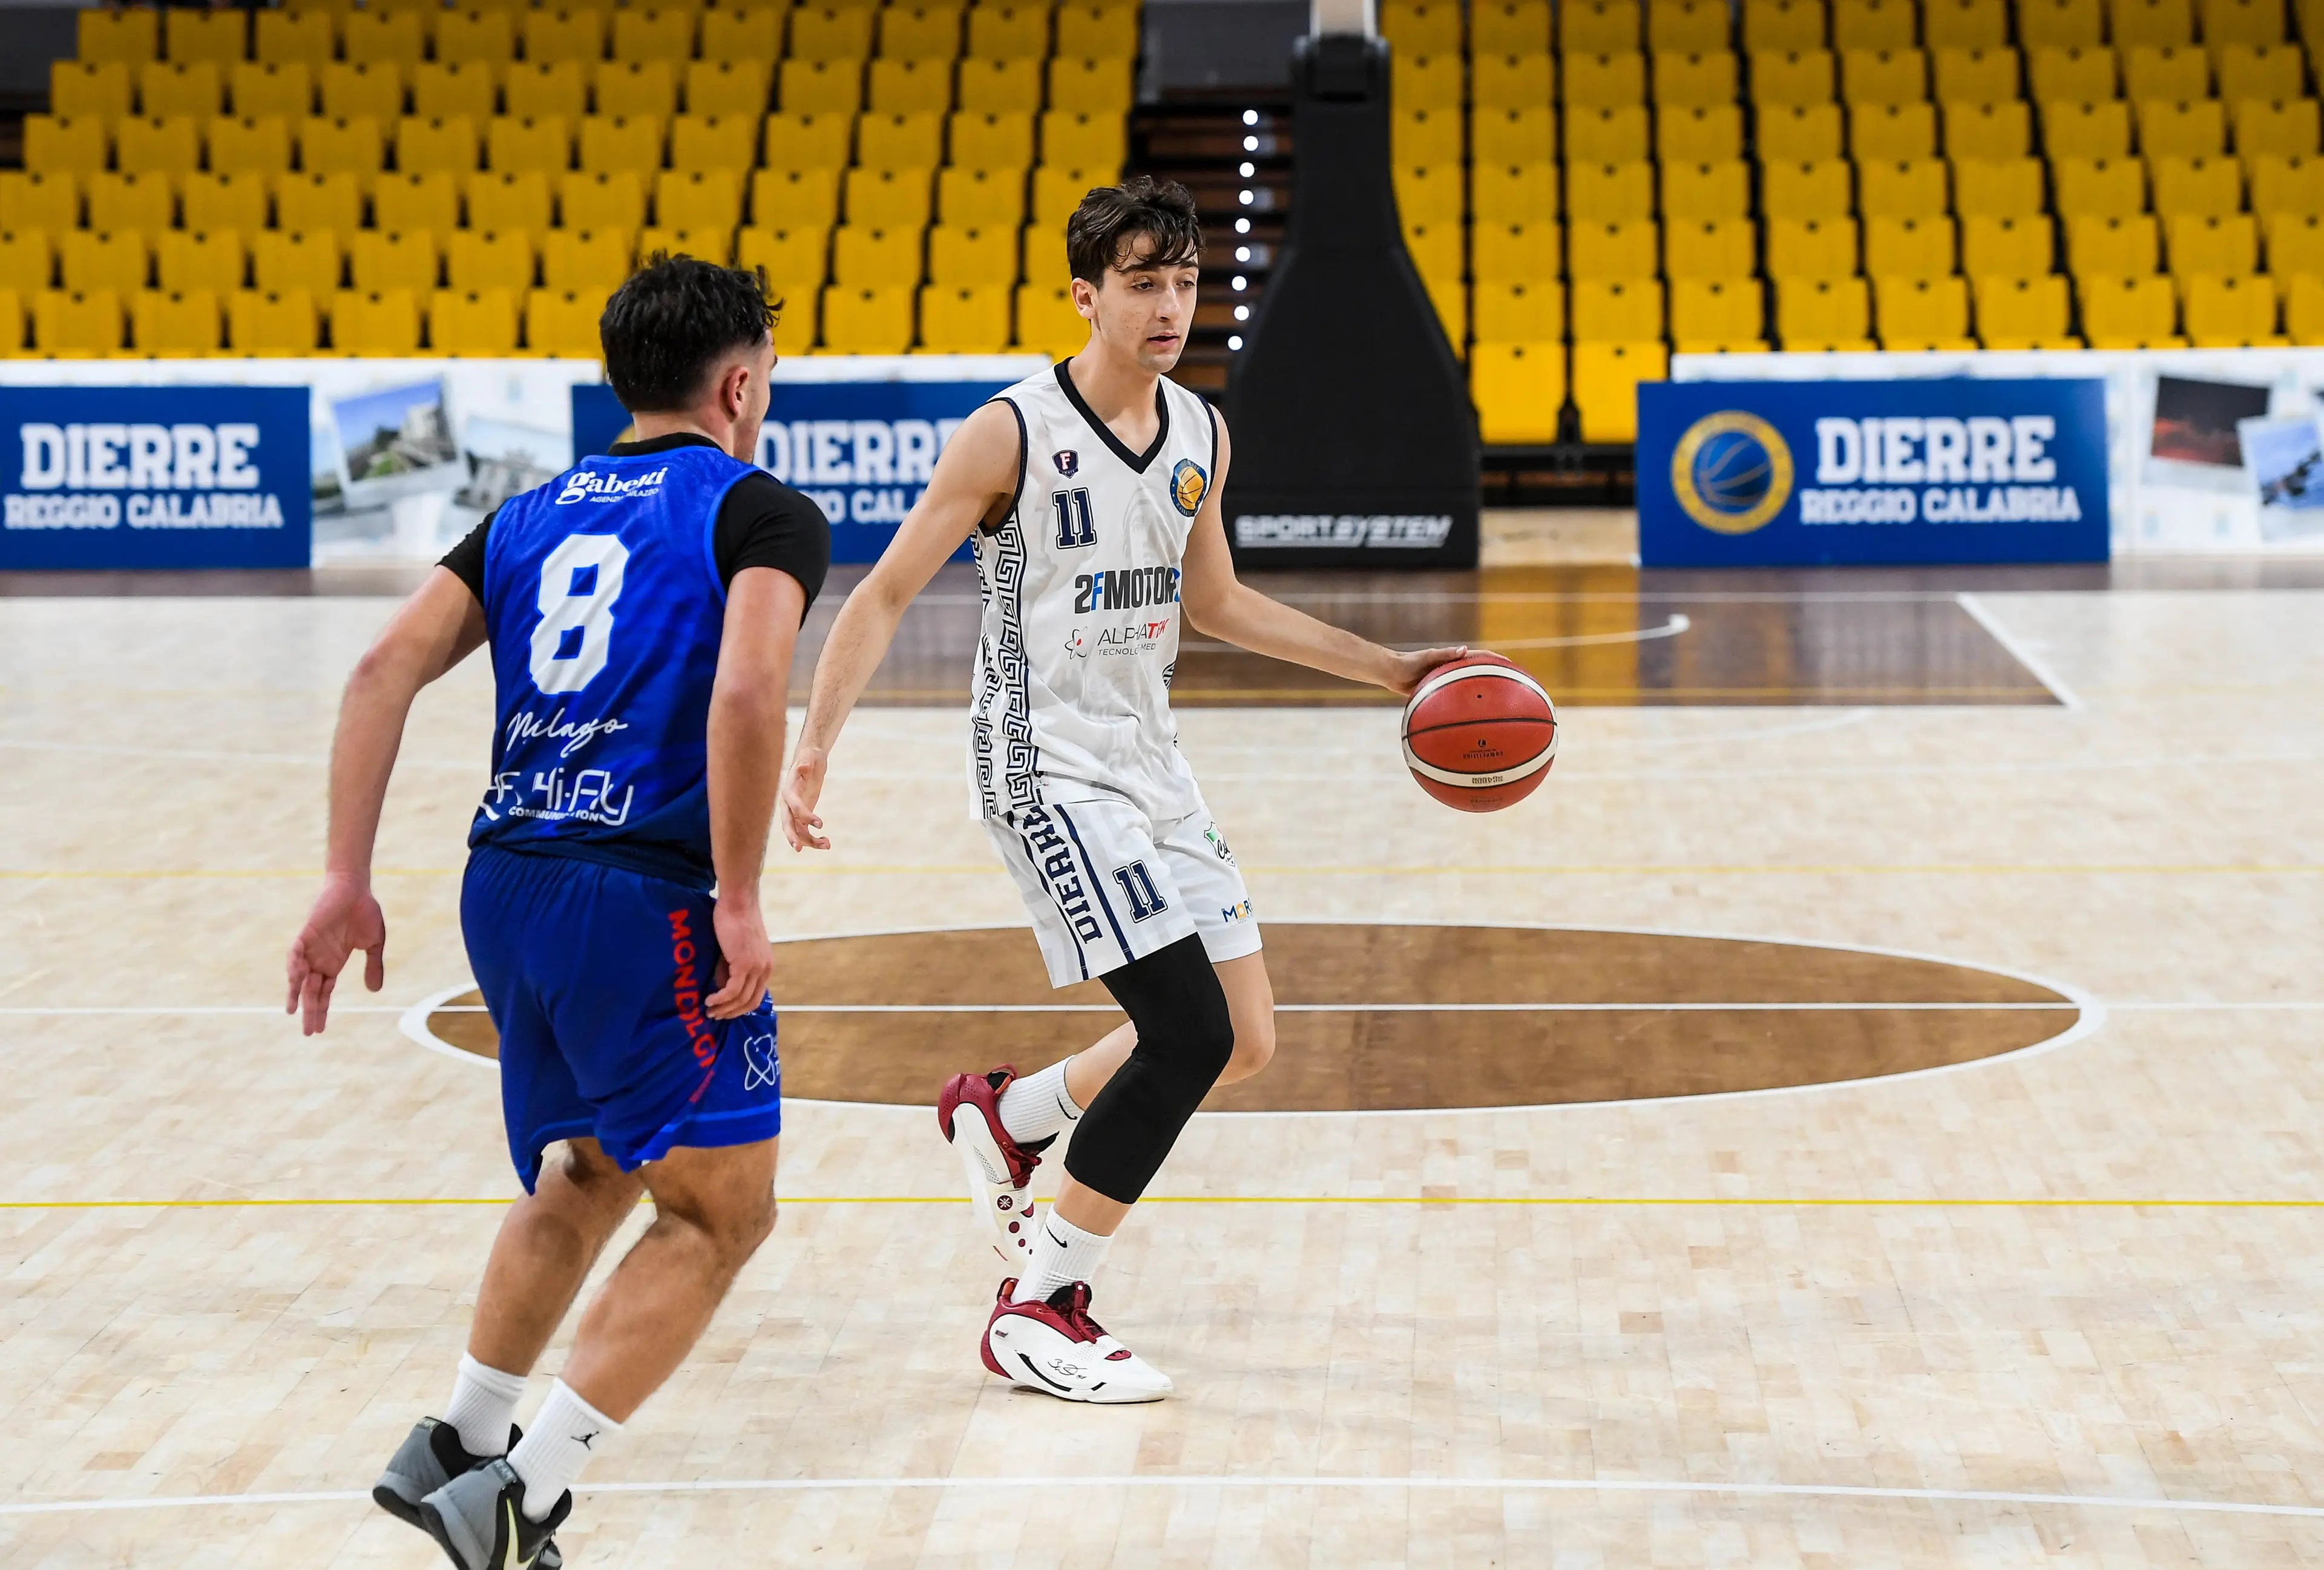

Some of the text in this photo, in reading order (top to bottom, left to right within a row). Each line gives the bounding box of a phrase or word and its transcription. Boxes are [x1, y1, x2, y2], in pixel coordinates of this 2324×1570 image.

[21, 424, 259, 489] DIERRE
[1816, 416, 2055, 484] DIERRE
[4, 494, 283, 528] REGGIO CALABRIA
[555, 467, 668, 504] gabetti
[1800, 487, 2081, 523] REGGIO CALABRIA
[1052, 487, 1097, 549] 11
[530, 534, 629, 695] 8
[1112, 859, 1168, 924] 11
